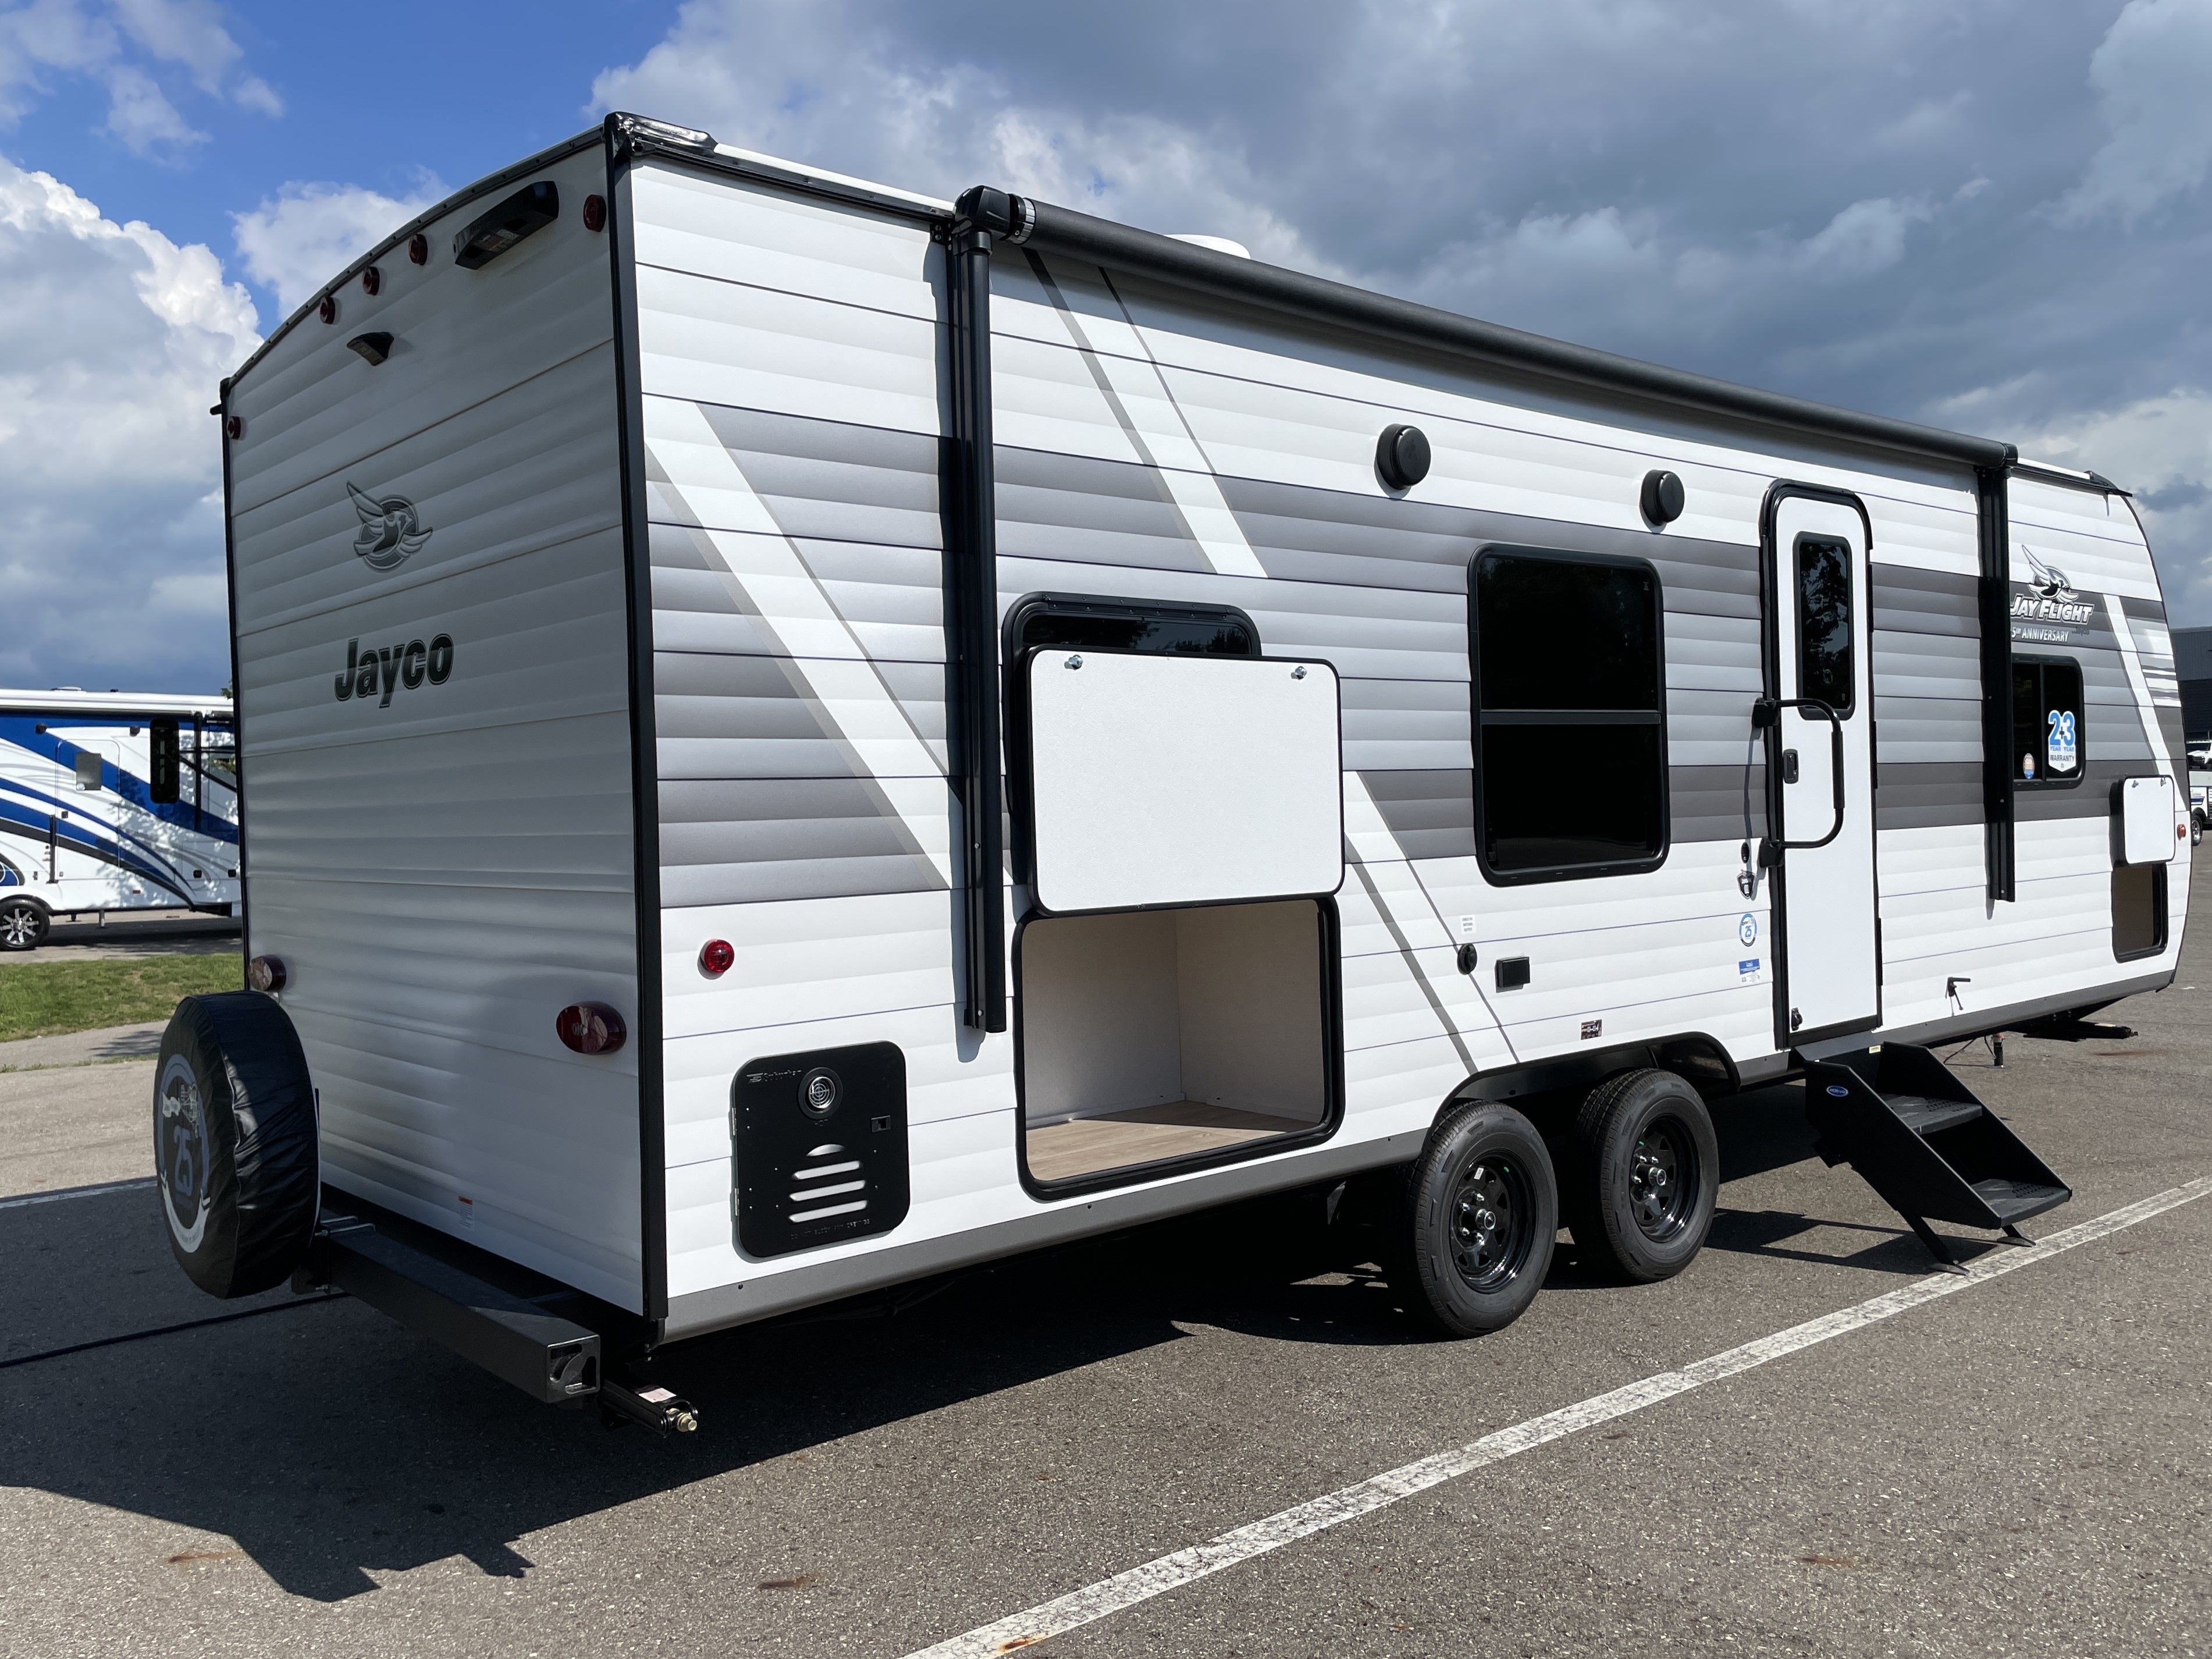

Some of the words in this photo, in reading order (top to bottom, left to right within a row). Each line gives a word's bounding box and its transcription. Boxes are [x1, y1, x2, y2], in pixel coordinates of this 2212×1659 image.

[2010, 596, 2038, 617] JAY
[2039, 599, 2093, 623] FLIGHT
[2022, 627, 2069, 642] ANNIVERSARY
[335, 633, 454, 709] Jayco
